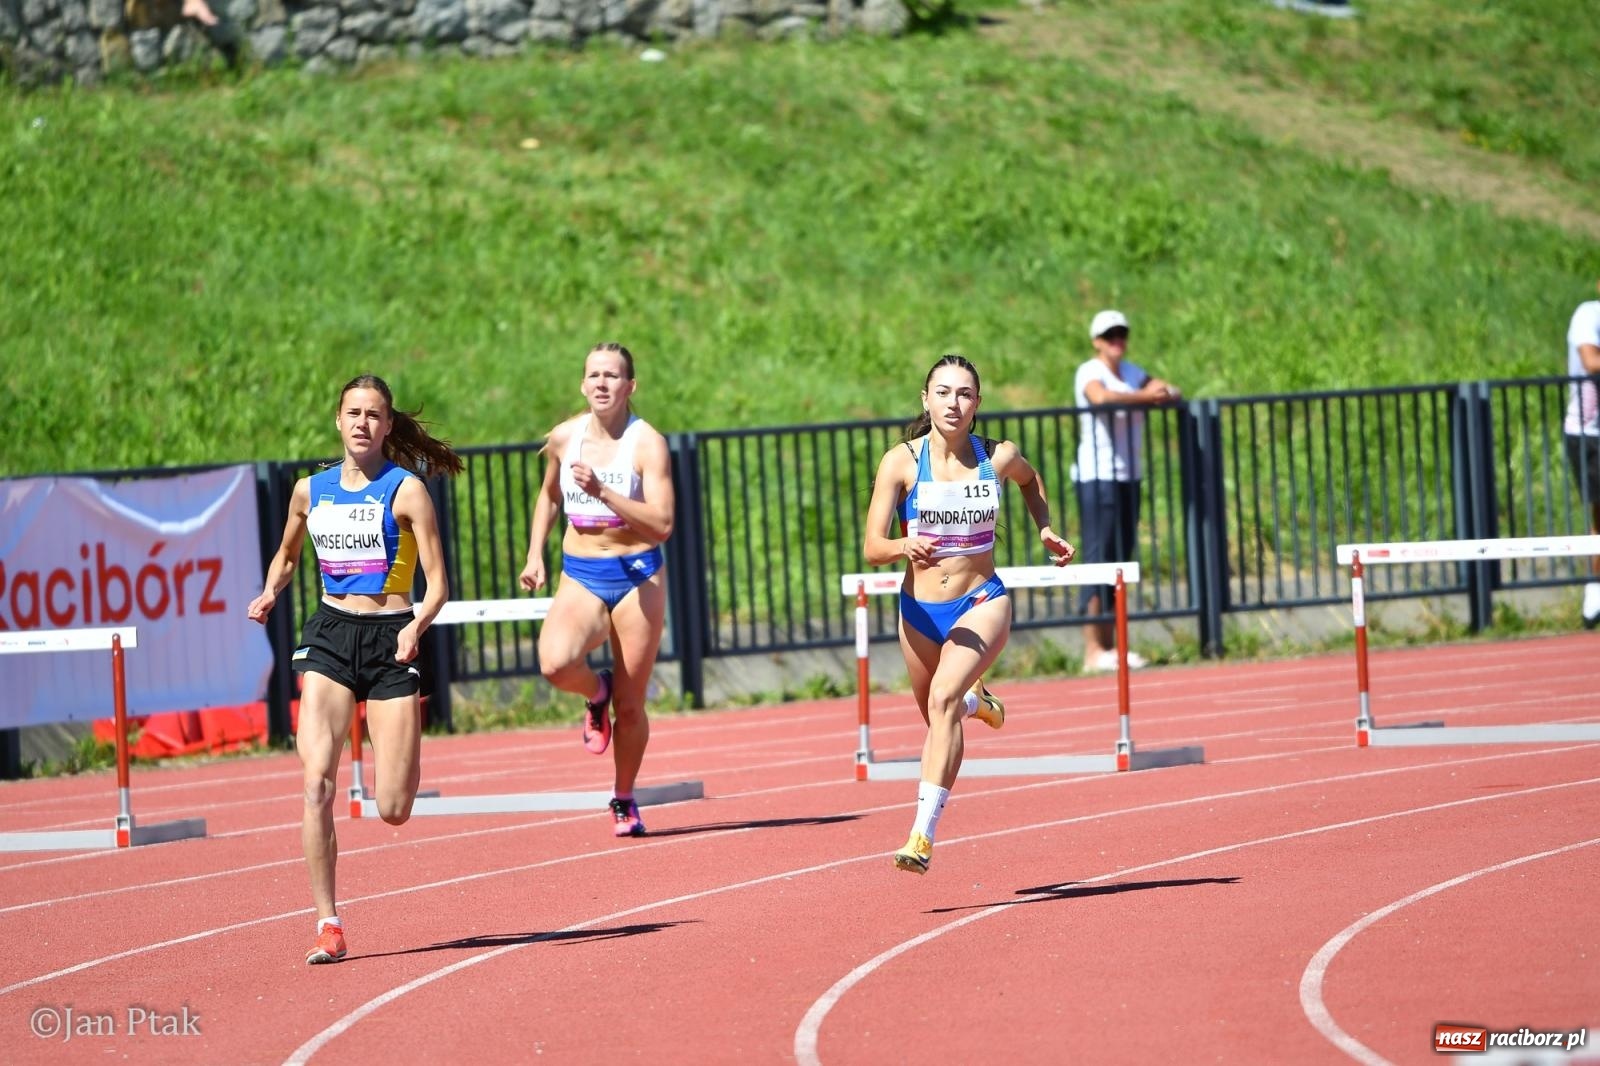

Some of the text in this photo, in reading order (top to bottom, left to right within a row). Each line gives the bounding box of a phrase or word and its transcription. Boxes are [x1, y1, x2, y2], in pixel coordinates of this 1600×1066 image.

[600, 471, 624, 484] 315
[963, 484, 990, 498] 115
[348, 508, 376, 521] 415
[920, 505, 995, 525] KUNDRÁTOVÁ
[312, 533, 382, 549] MOSEICHUK
